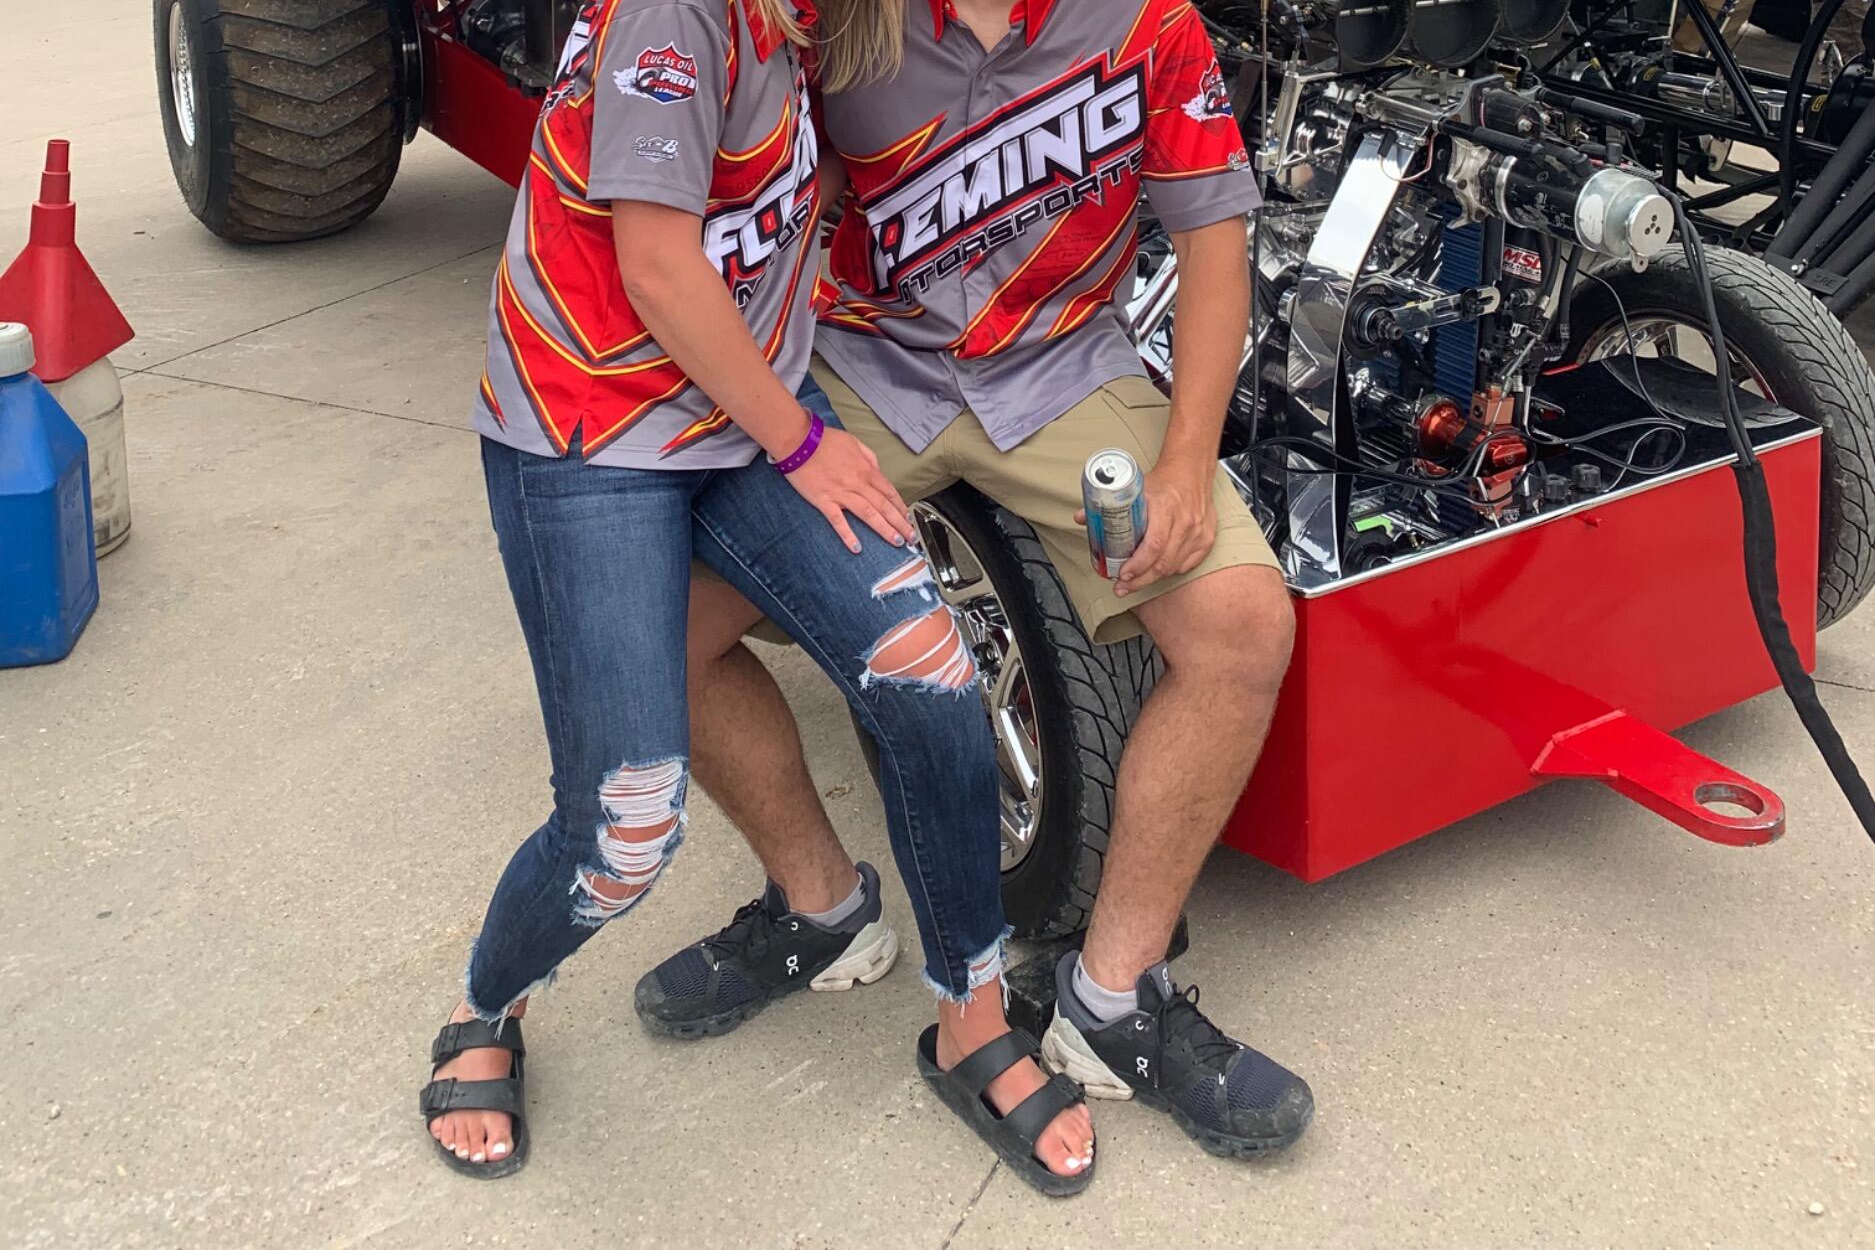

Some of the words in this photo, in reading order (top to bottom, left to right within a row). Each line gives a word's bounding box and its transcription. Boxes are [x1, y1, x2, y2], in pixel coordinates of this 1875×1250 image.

[644, 55, 676, 67] LUCAS
[677, 60, 693, 71] OIL
[897, 146, 1144, 302] TORSPORTS
